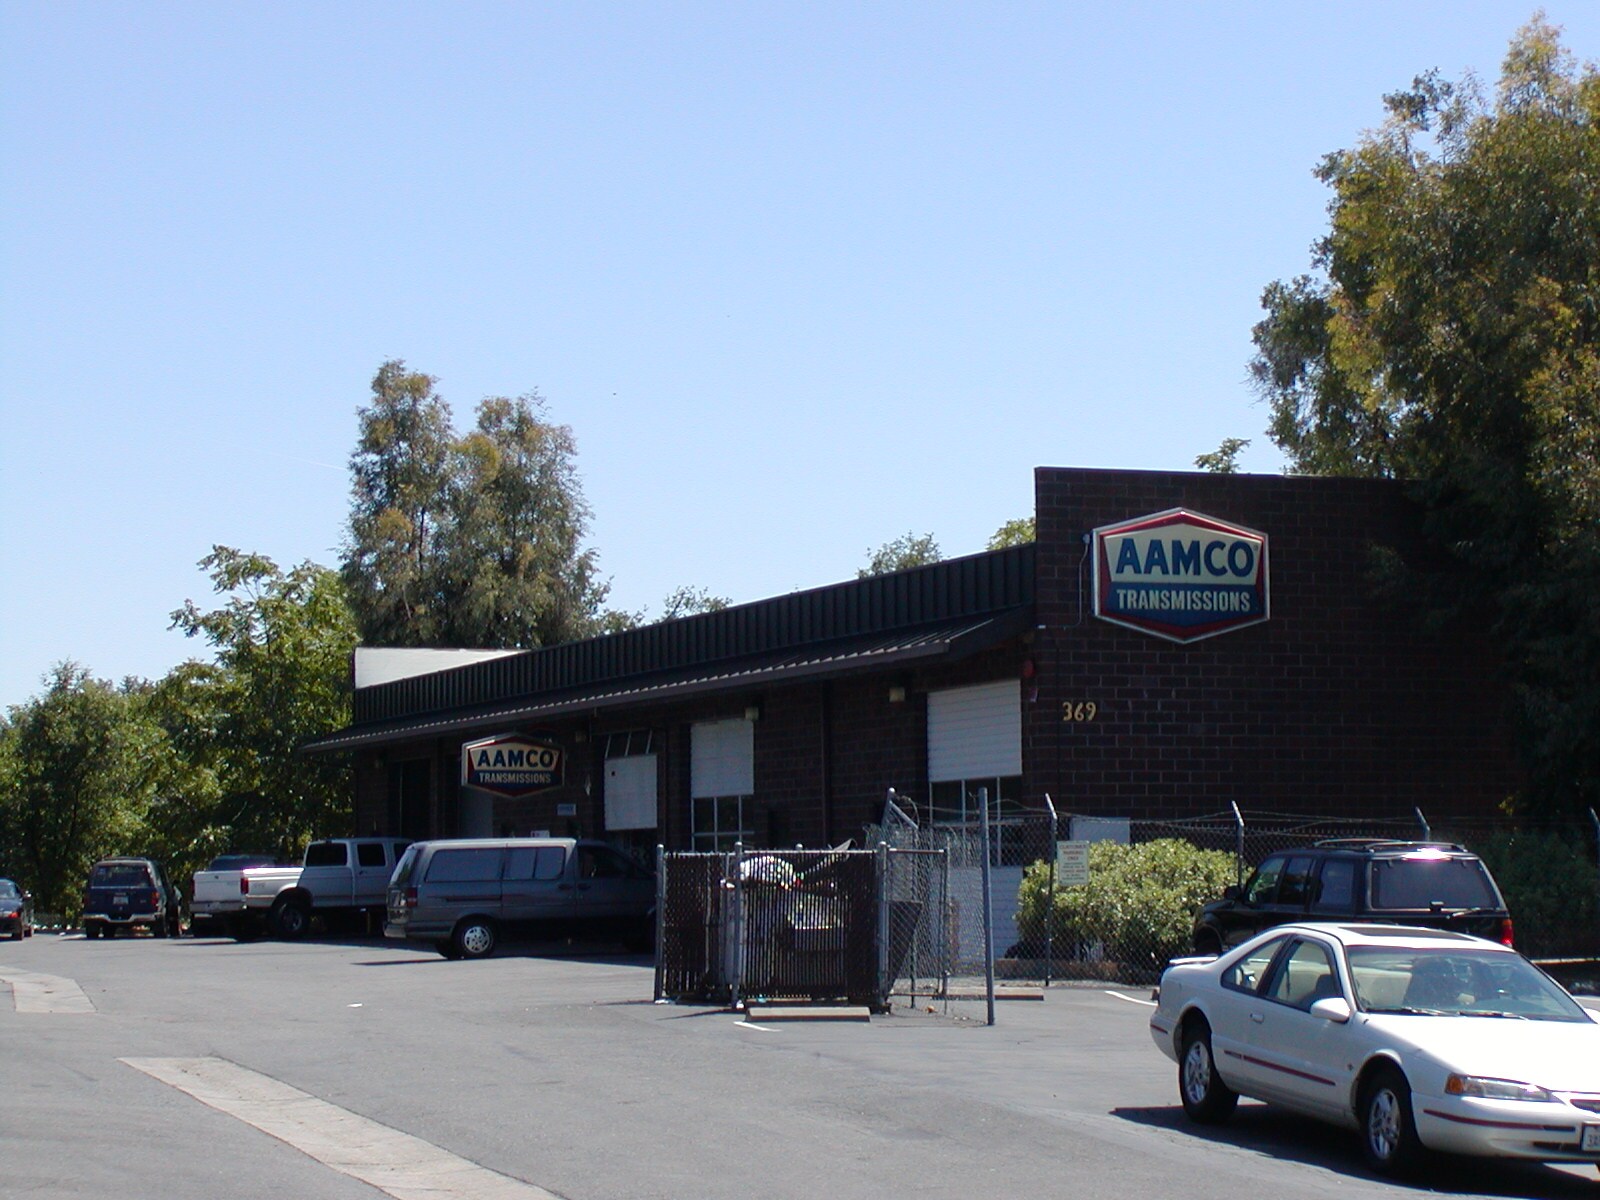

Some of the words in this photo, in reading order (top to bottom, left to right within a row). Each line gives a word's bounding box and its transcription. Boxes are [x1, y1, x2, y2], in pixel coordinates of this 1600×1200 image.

[1116, 538, 1254, 577] AAMCO
[1117, 589, 1250, 612] TRANSMISSIONS
[1063, 701, 1096, 721] 369
[478, 749, 554, 768] AAMCO
[479, 772, 551, 784] TRANSMISSIONS
